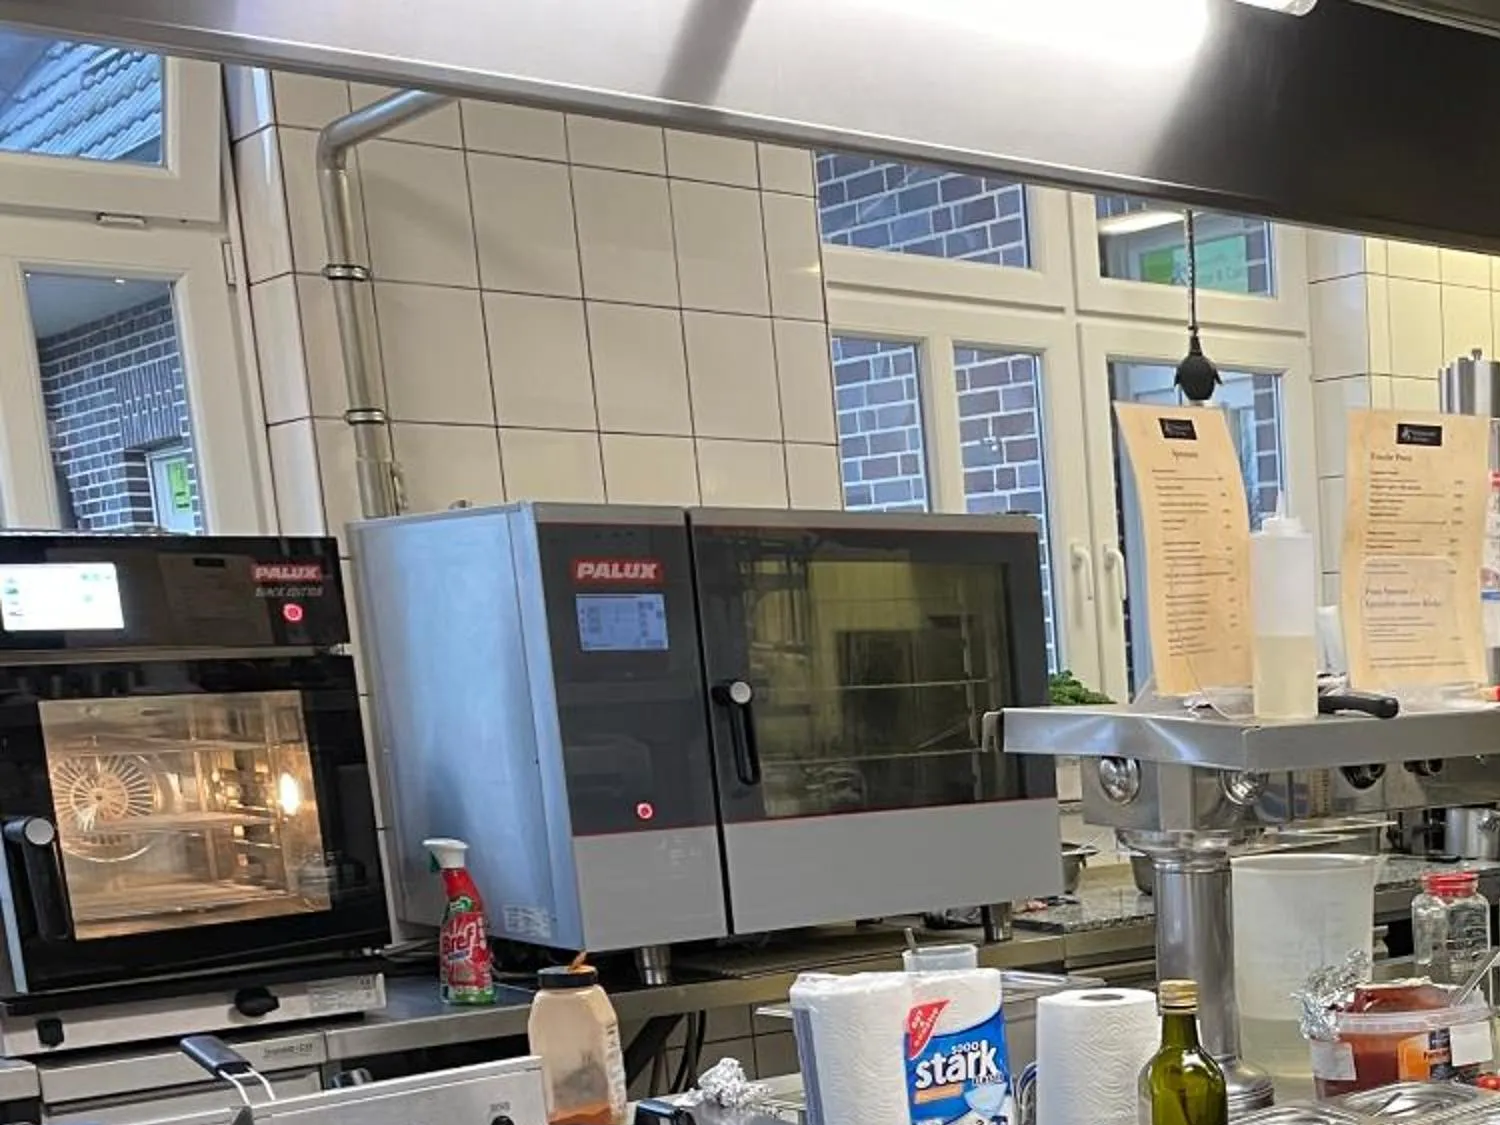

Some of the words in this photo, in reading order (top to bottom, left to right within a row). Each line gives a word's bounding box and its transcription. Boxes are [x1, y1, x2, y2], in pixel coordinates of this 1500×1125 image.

[255, 565, 318, 579] PALUX
[577, 562, 657, 579] PALUX
[915, 1039, 999, 1089] stark
